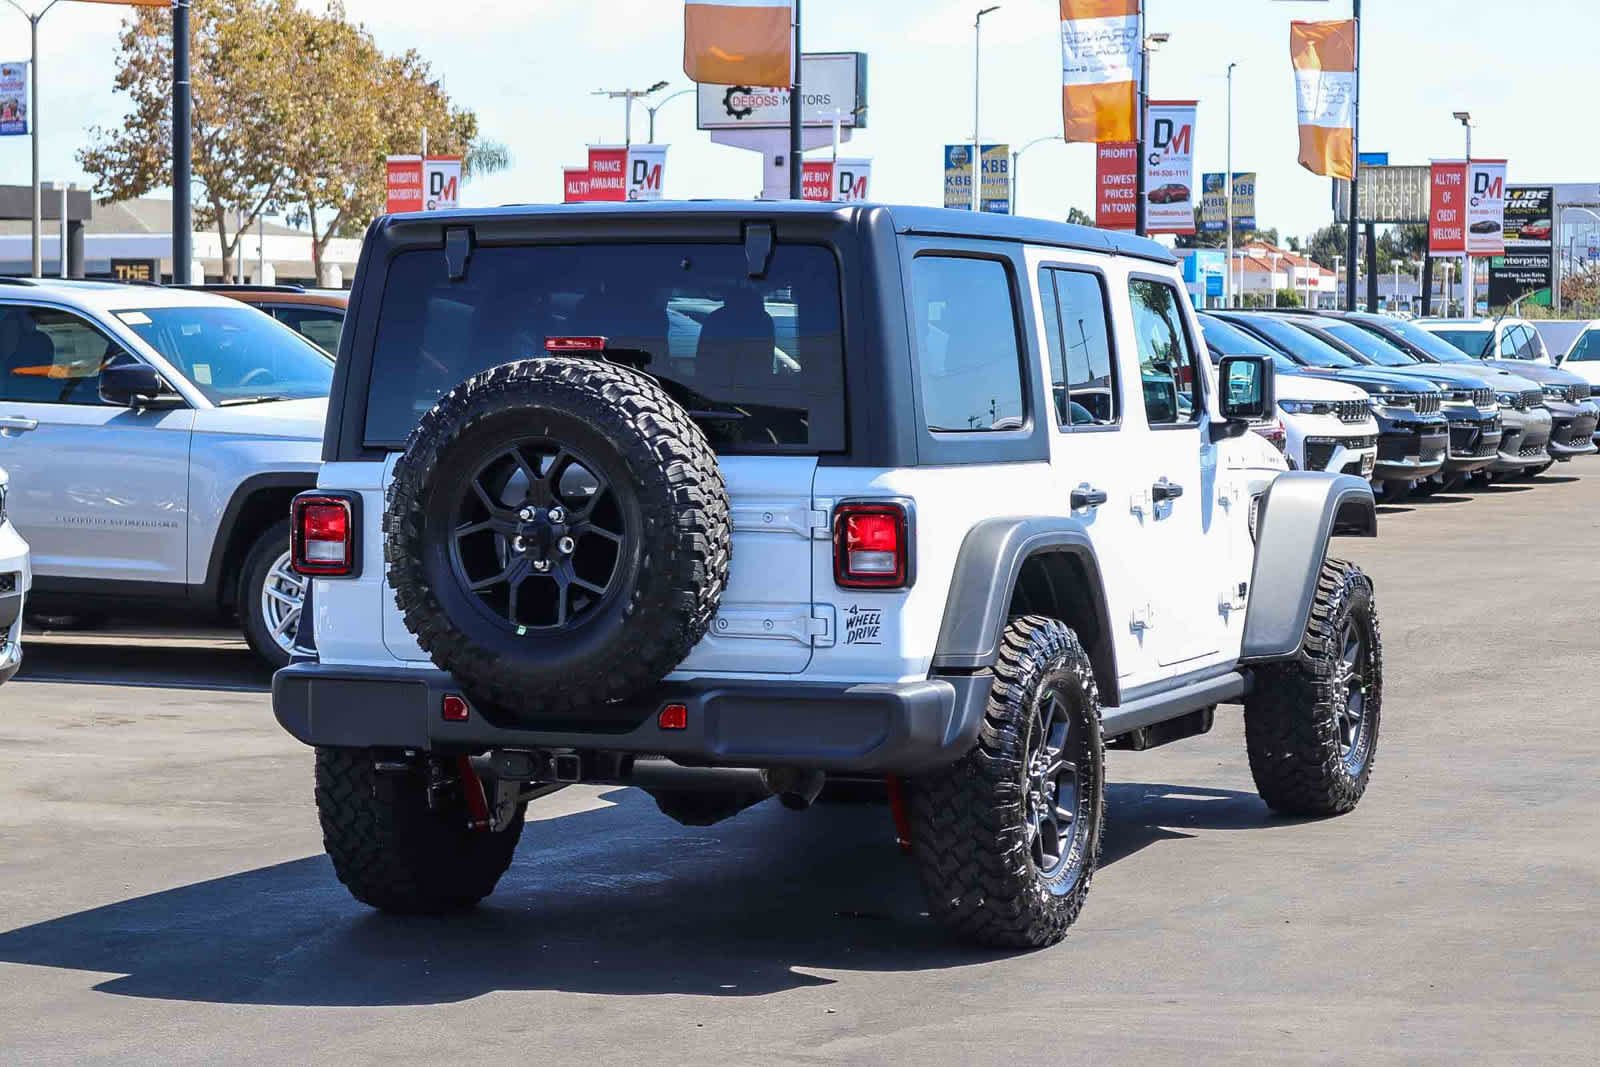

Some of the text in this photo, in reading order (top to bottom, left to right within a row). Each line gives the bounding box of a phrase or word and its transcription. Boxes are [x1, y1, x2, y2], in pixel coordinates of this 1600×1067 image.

[733, 94, 831, 107] DEBOSS MTORS
[981, 159, 1008, 173] KBB
[802, 171, 831, 183] WE BUY
[945, 175, 972, 186] KBB
[1103, 174, 1137, 185] LOWEST
[802, 186, 822, 198] CARS
[1104, 188, 1135, 199] PRICES
[1442, 191, 1451, 204] OF
[1102, 202, 1111, 213] IN
[1504, 200, 1540, 208] TIRE
[1436, 209, 1457, 222] CREDIT
[1432, 227, 1462, 240] WELCOME
[115, 264, 150, 280] THE
[849, 604, 859, 615] 4
[846, 613, 881, 630] WHEEL
[846, 626, 881, 645] DRIVE
